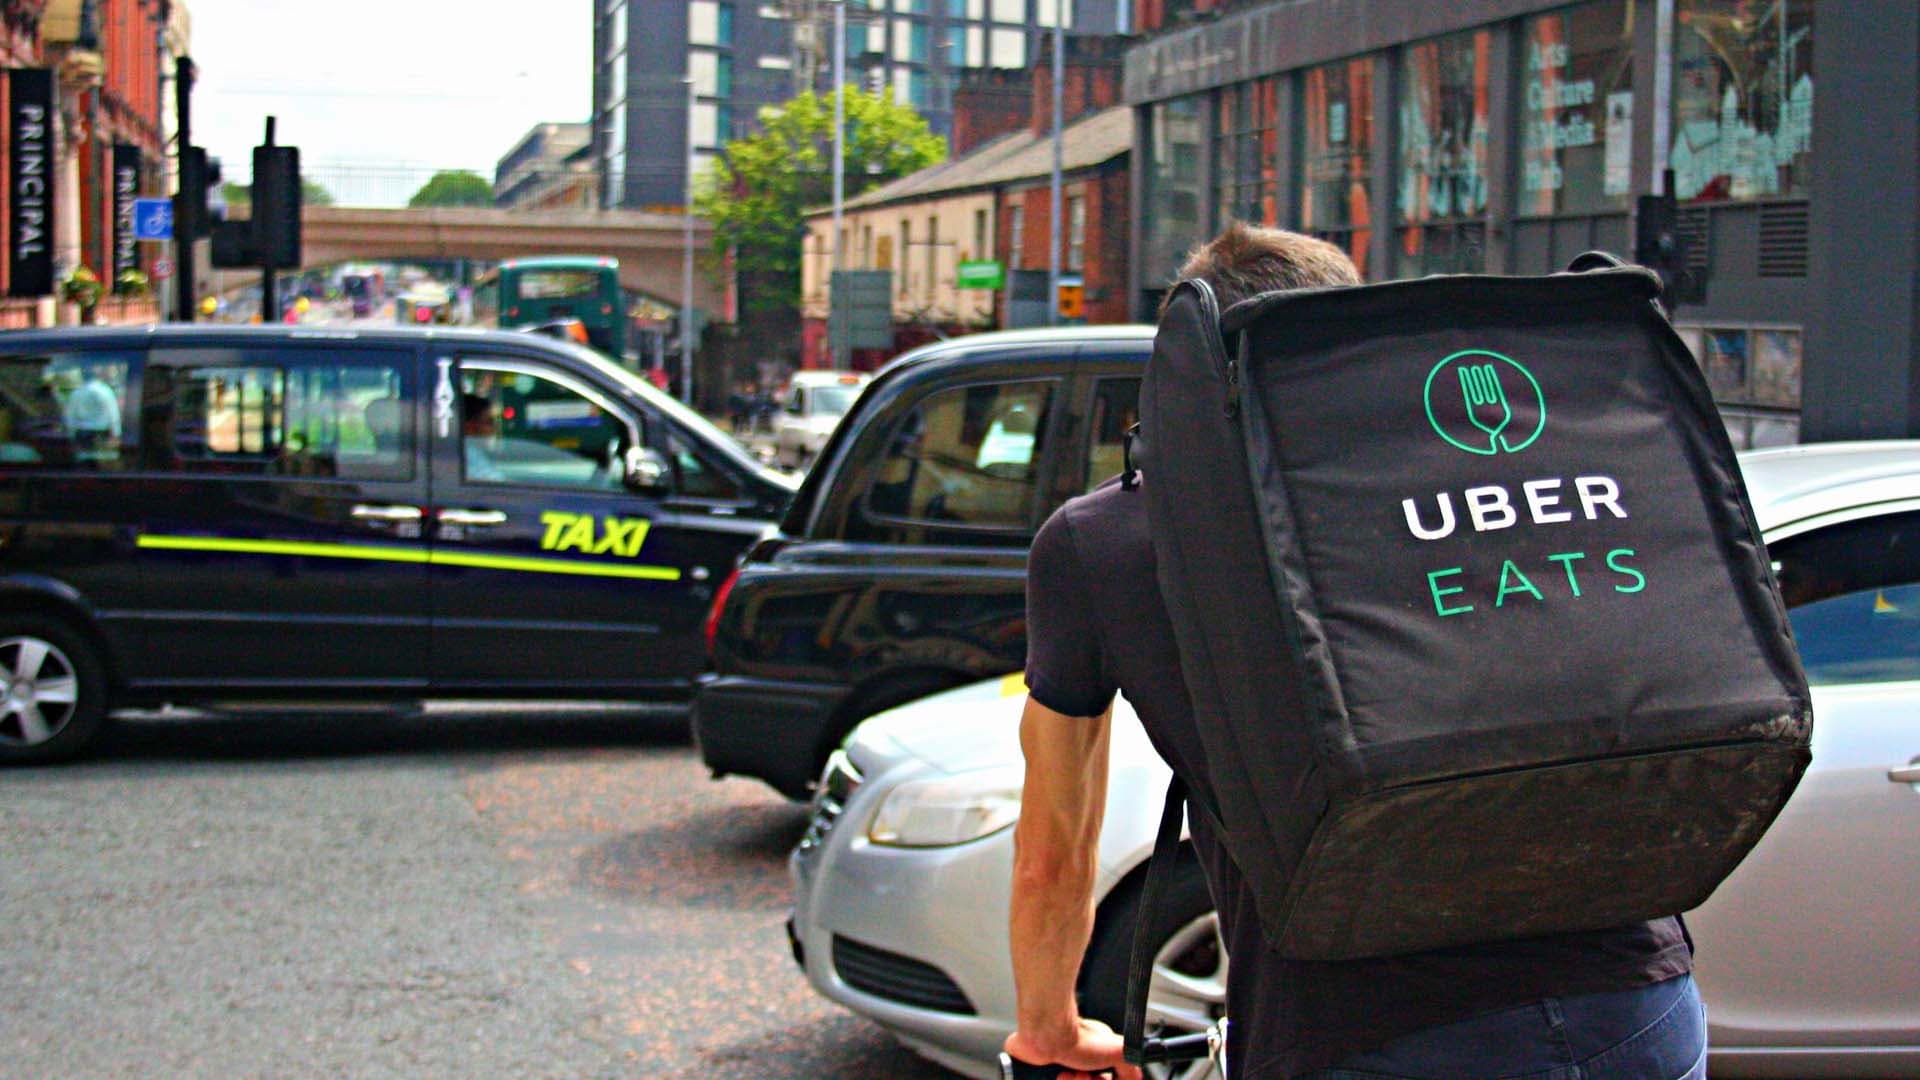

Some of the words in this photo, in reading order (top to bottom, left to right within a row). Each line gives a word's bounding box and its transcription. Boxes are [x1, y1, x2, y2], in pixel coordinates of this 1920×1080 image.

[1528, 78, 1595, 110] Culture
[18, 104, 44, 260] PRINCIPAL
[118, 166, 136, 269] PRINCIPAL
[540, 510, 651, 557] TAXI
[1402, 476, 1628, 540] UBER
[1427, 549, 1646, 616] EATS
